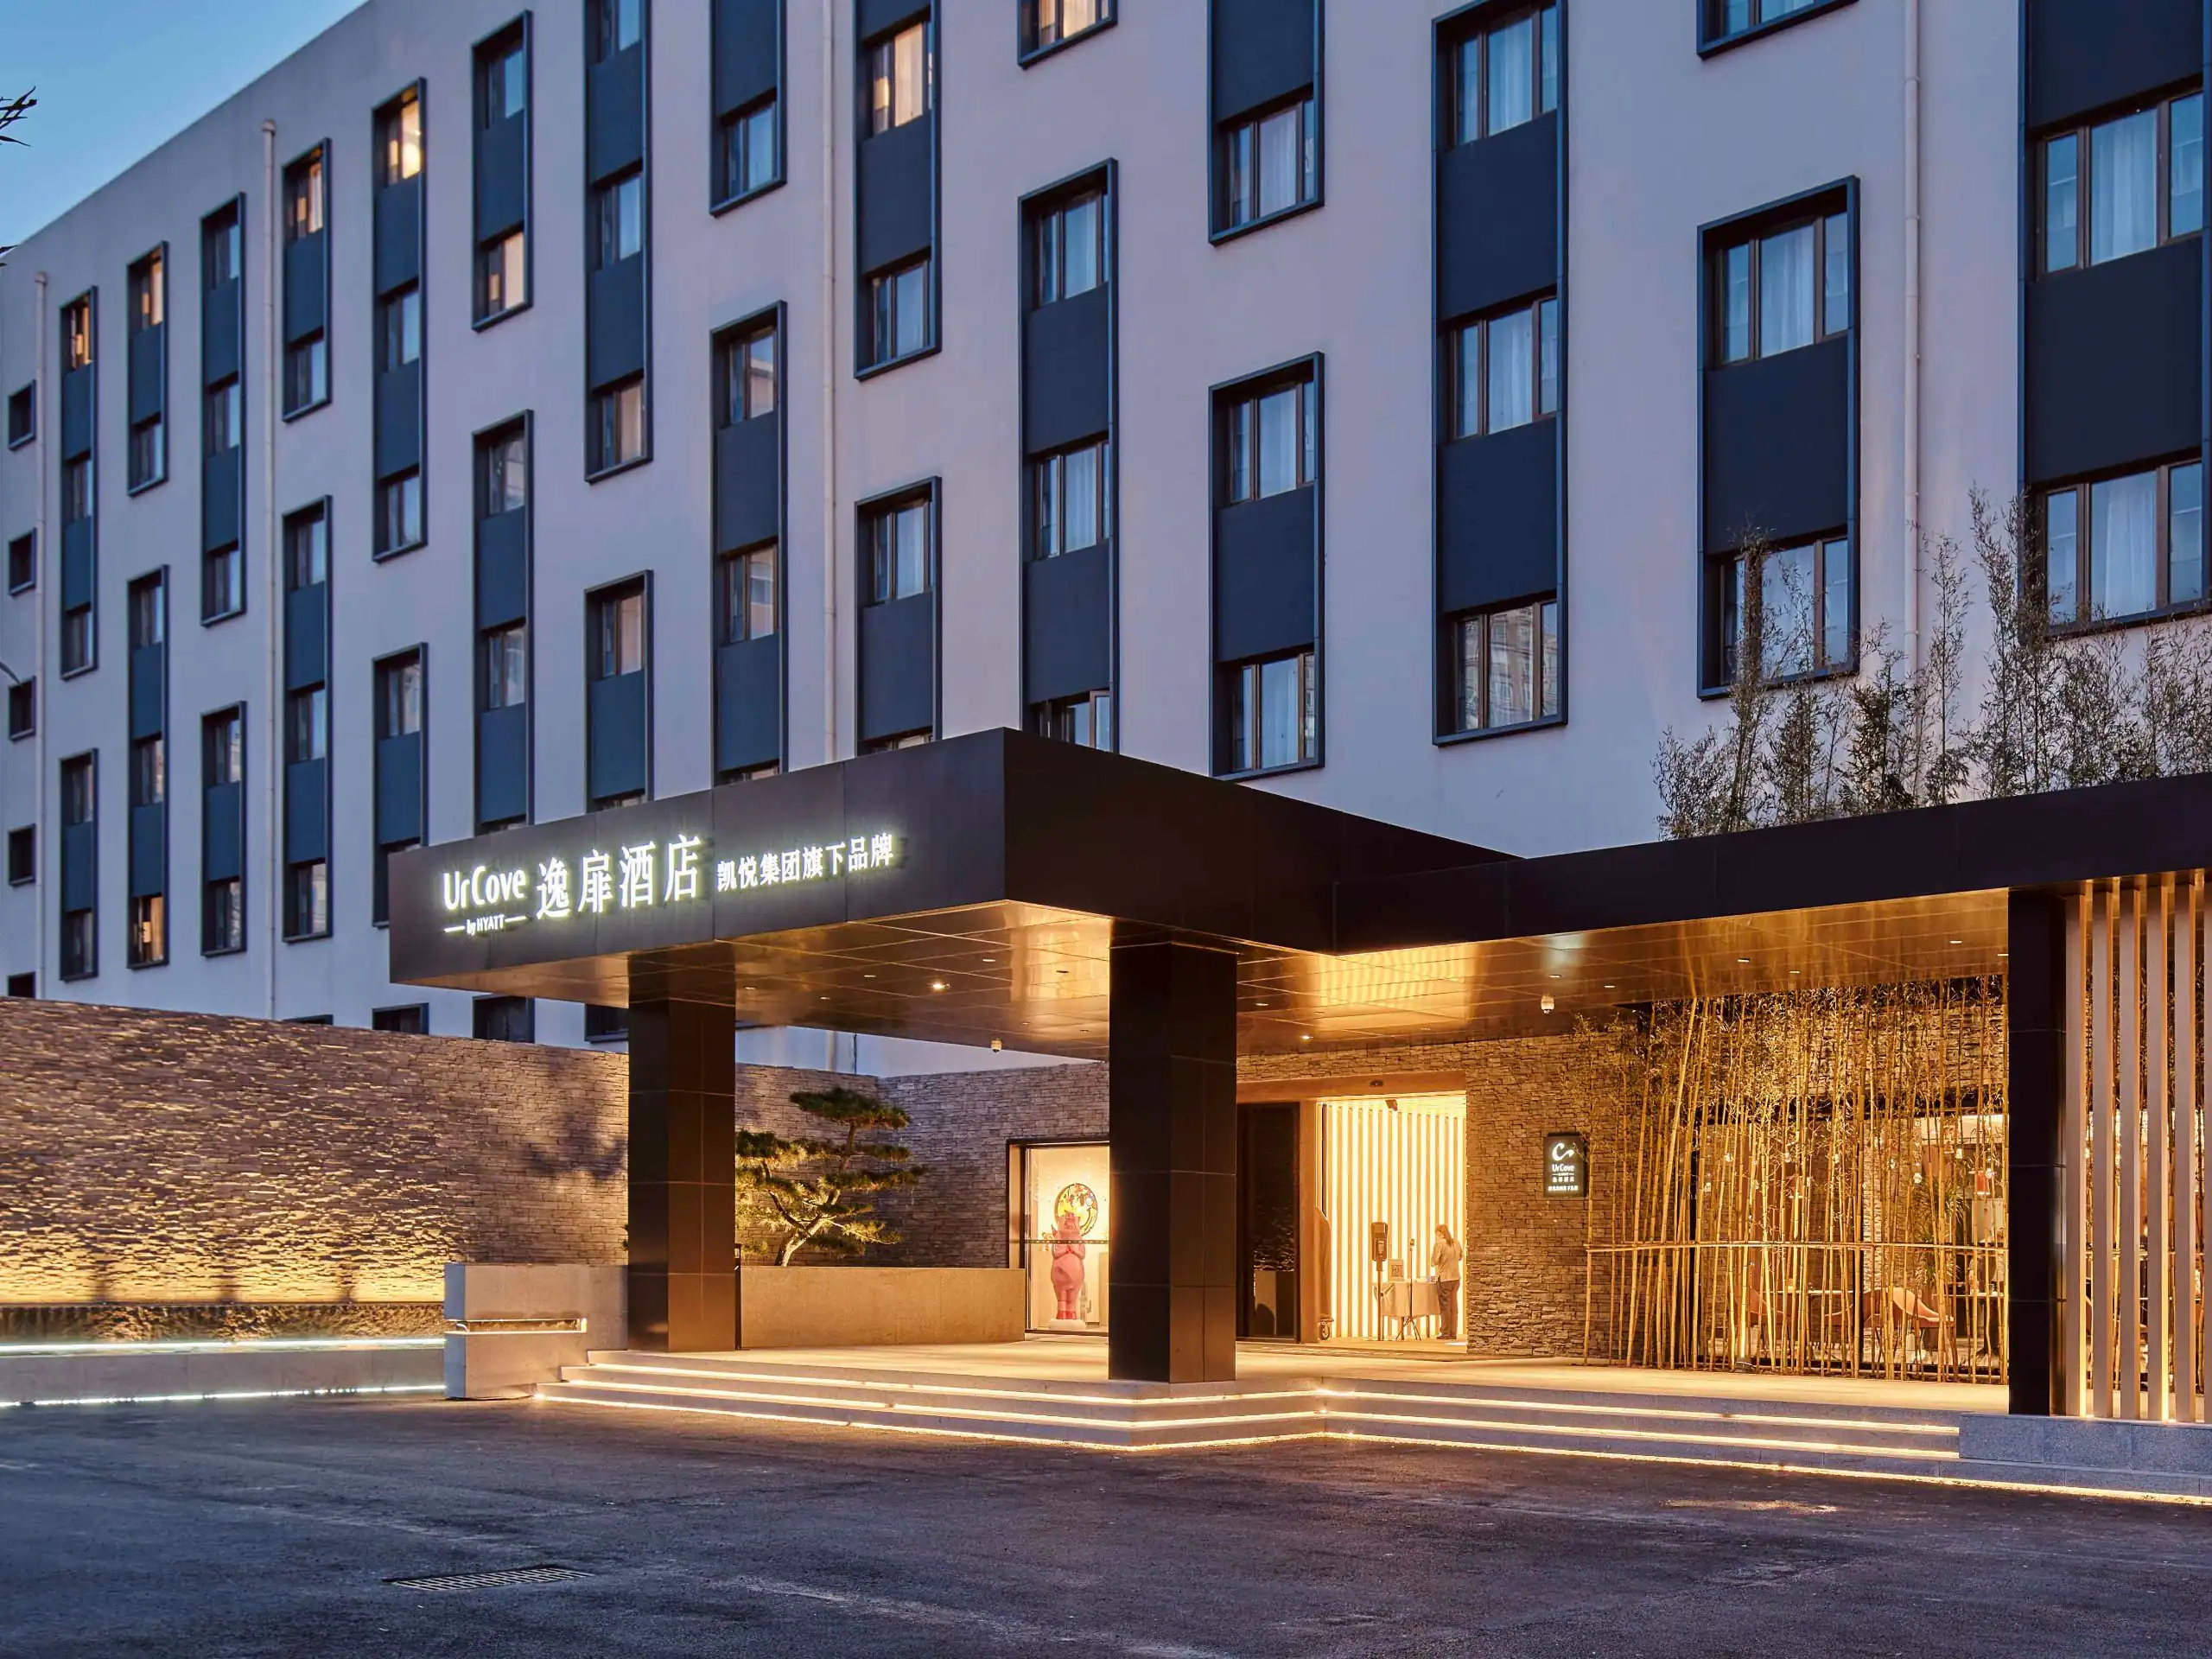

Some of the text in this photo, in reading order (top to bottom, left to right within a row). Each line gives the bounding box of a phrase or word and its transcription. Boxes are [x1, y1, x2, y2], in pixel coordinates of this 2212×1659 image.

[443, 865, 526, 910] UrCove
[537, 834, 701, 919] 逸扉酒店
[717, 832, 893, 893] 凯悦集团旗下品牌
[467, 913, 505, 936] by HYATT
